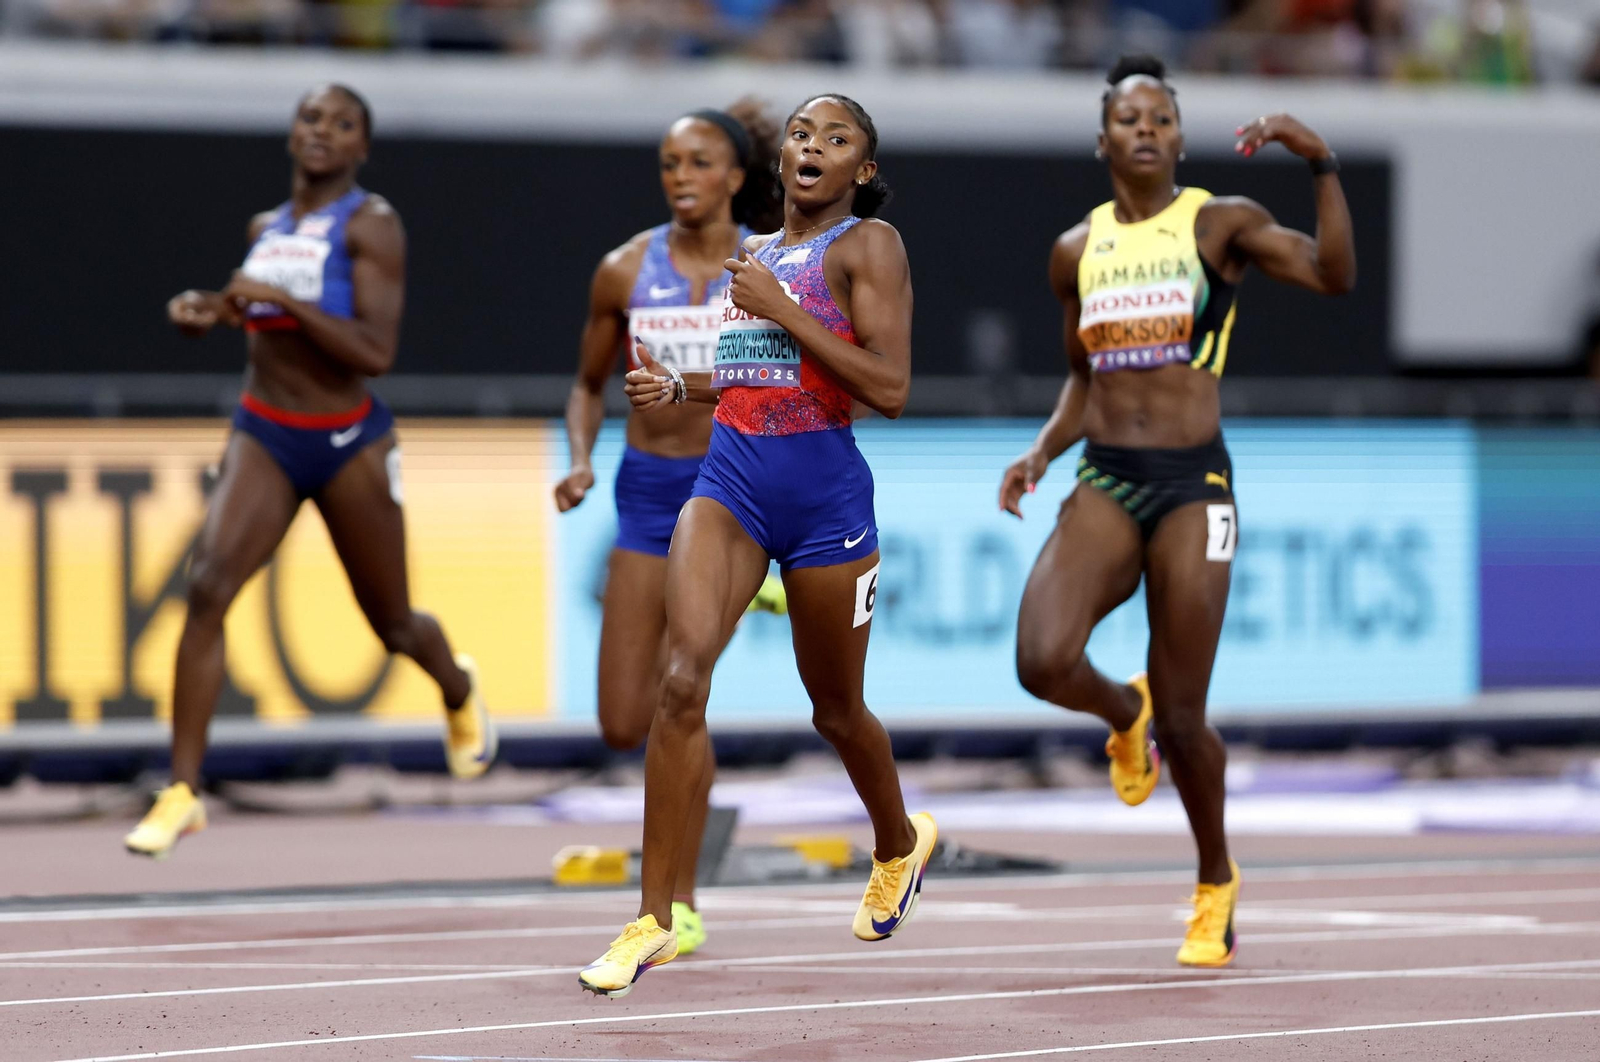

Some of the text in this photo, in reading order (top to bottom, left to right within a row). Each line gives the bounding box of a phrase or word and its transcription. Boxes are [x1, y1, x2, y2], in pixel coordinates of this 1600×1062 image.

[1087, 258, 1189, 291] JAMAICA
[1083, 289, 1187, 315] HONDA
[636, 314, 721, 332] HOND
[1221, 516, 1231, 551] 7
[865, 572, 878, 613] 6
